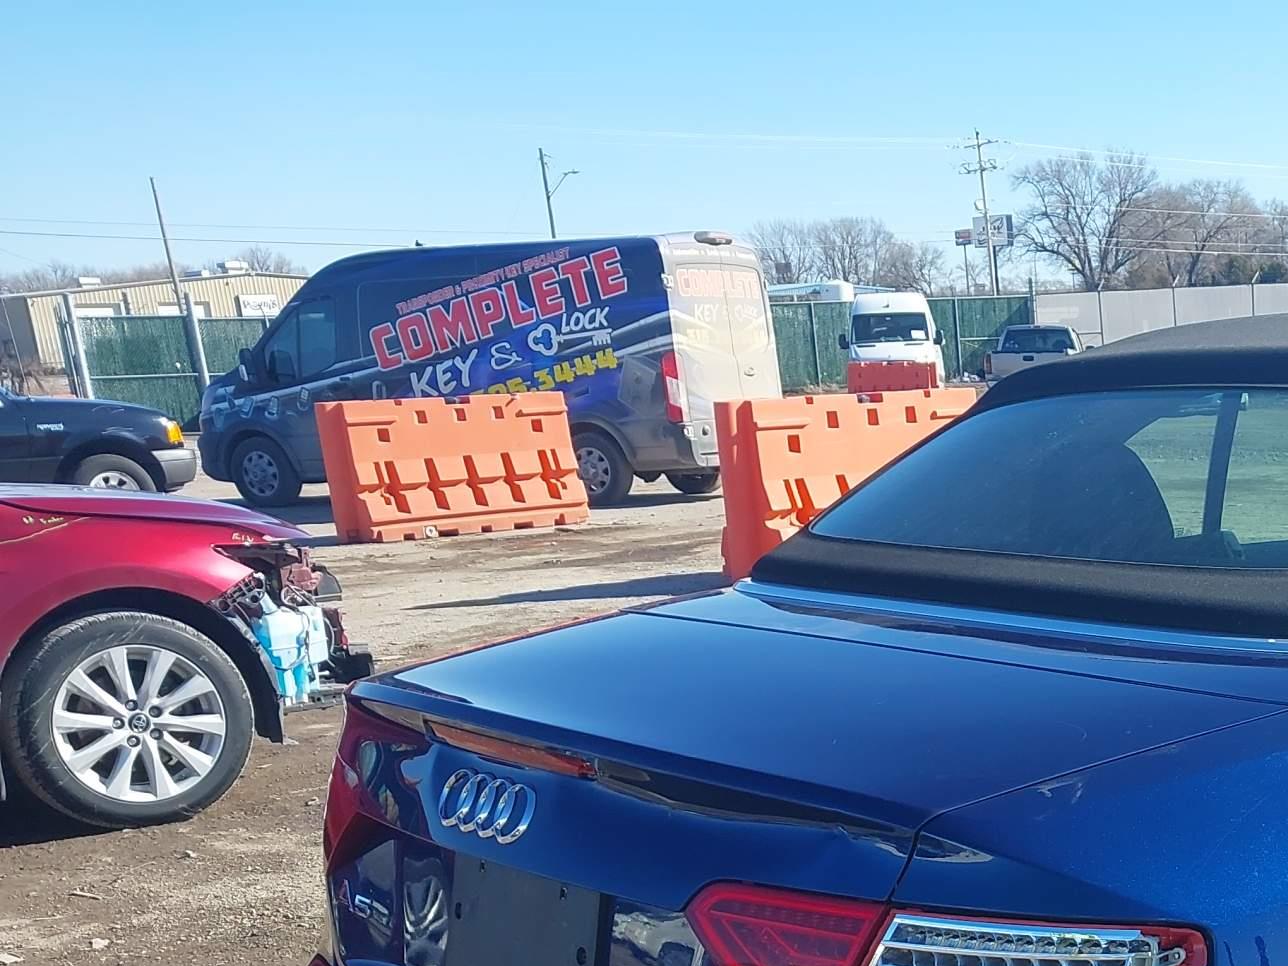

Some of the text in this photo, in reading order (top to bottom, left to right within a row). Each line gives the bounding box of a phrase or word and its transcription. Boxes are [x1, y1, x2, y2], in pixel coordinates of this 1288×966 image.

[369, 246, 628, 371] COMPLETE
[409, 305, 610, 399] KEY & LOCK
